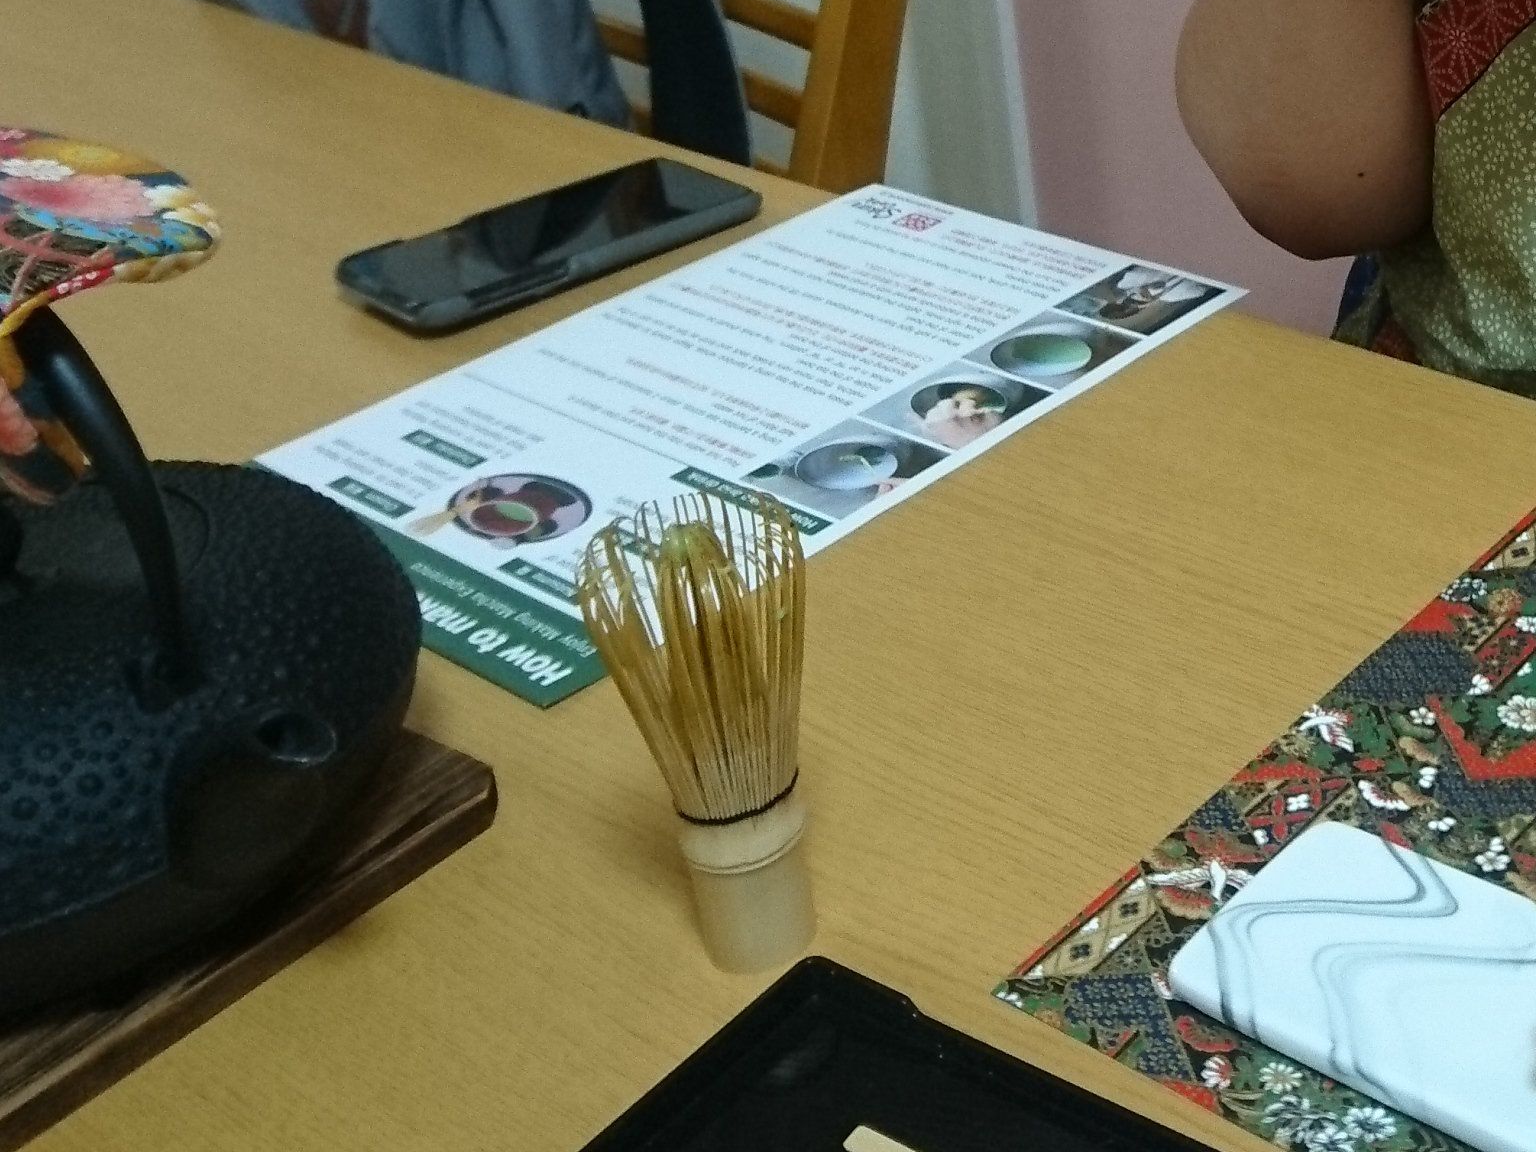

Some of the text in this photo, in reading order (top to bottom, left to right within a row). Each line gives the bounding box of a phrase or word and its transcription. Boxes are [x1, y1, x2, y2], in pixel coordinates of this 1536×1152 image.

[410, 561, 596, 657] Enjoy Making Matcha Experience
[468, 629, 508, 652] to
[498, 645, 572, 685] How
